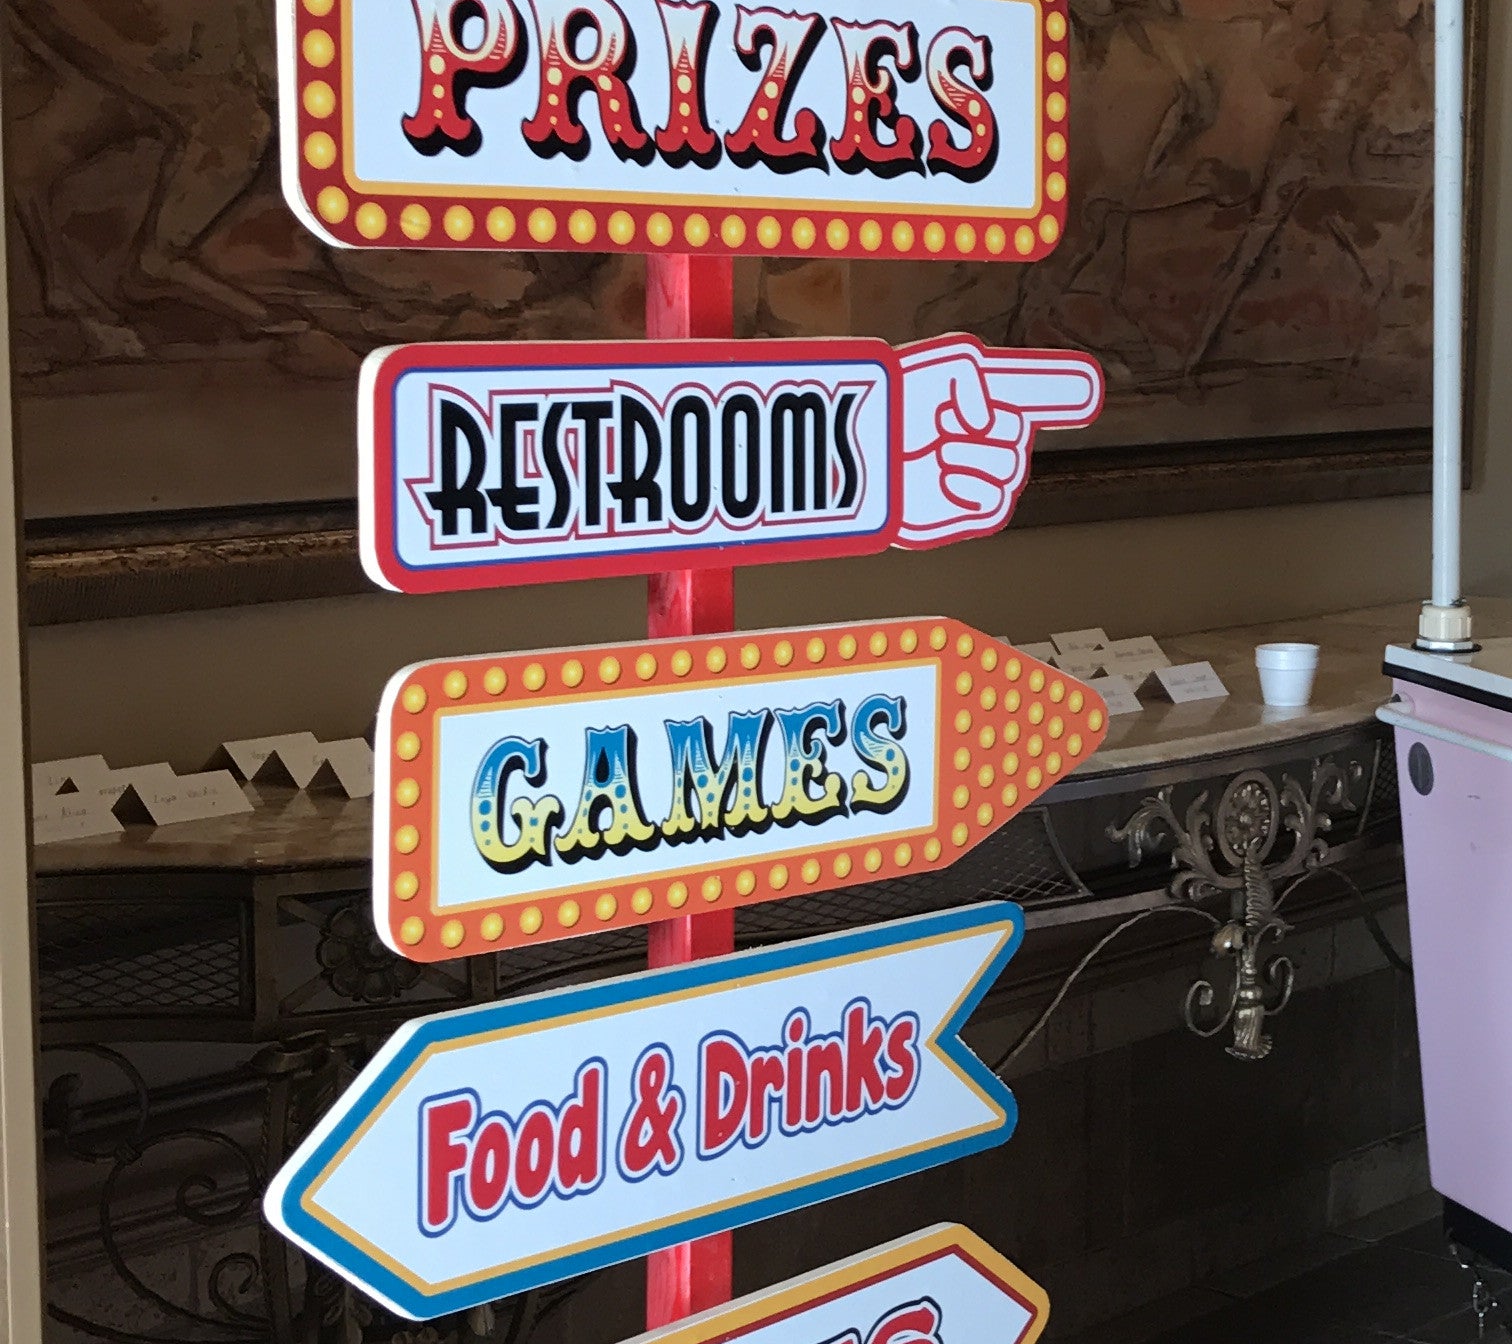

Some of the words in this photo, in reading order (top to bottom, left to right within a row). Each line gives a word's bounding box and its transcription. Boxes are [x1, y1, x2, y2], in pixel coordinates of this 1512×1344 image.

[420, 387, 864, 541] RESTROOMS
[469, 695, 909, 874] GAMES
[424, 1060, 602, 1229] Food
[622, 1044, 677, 1172] &
[702, 1002, 916, 1151] Drinks
